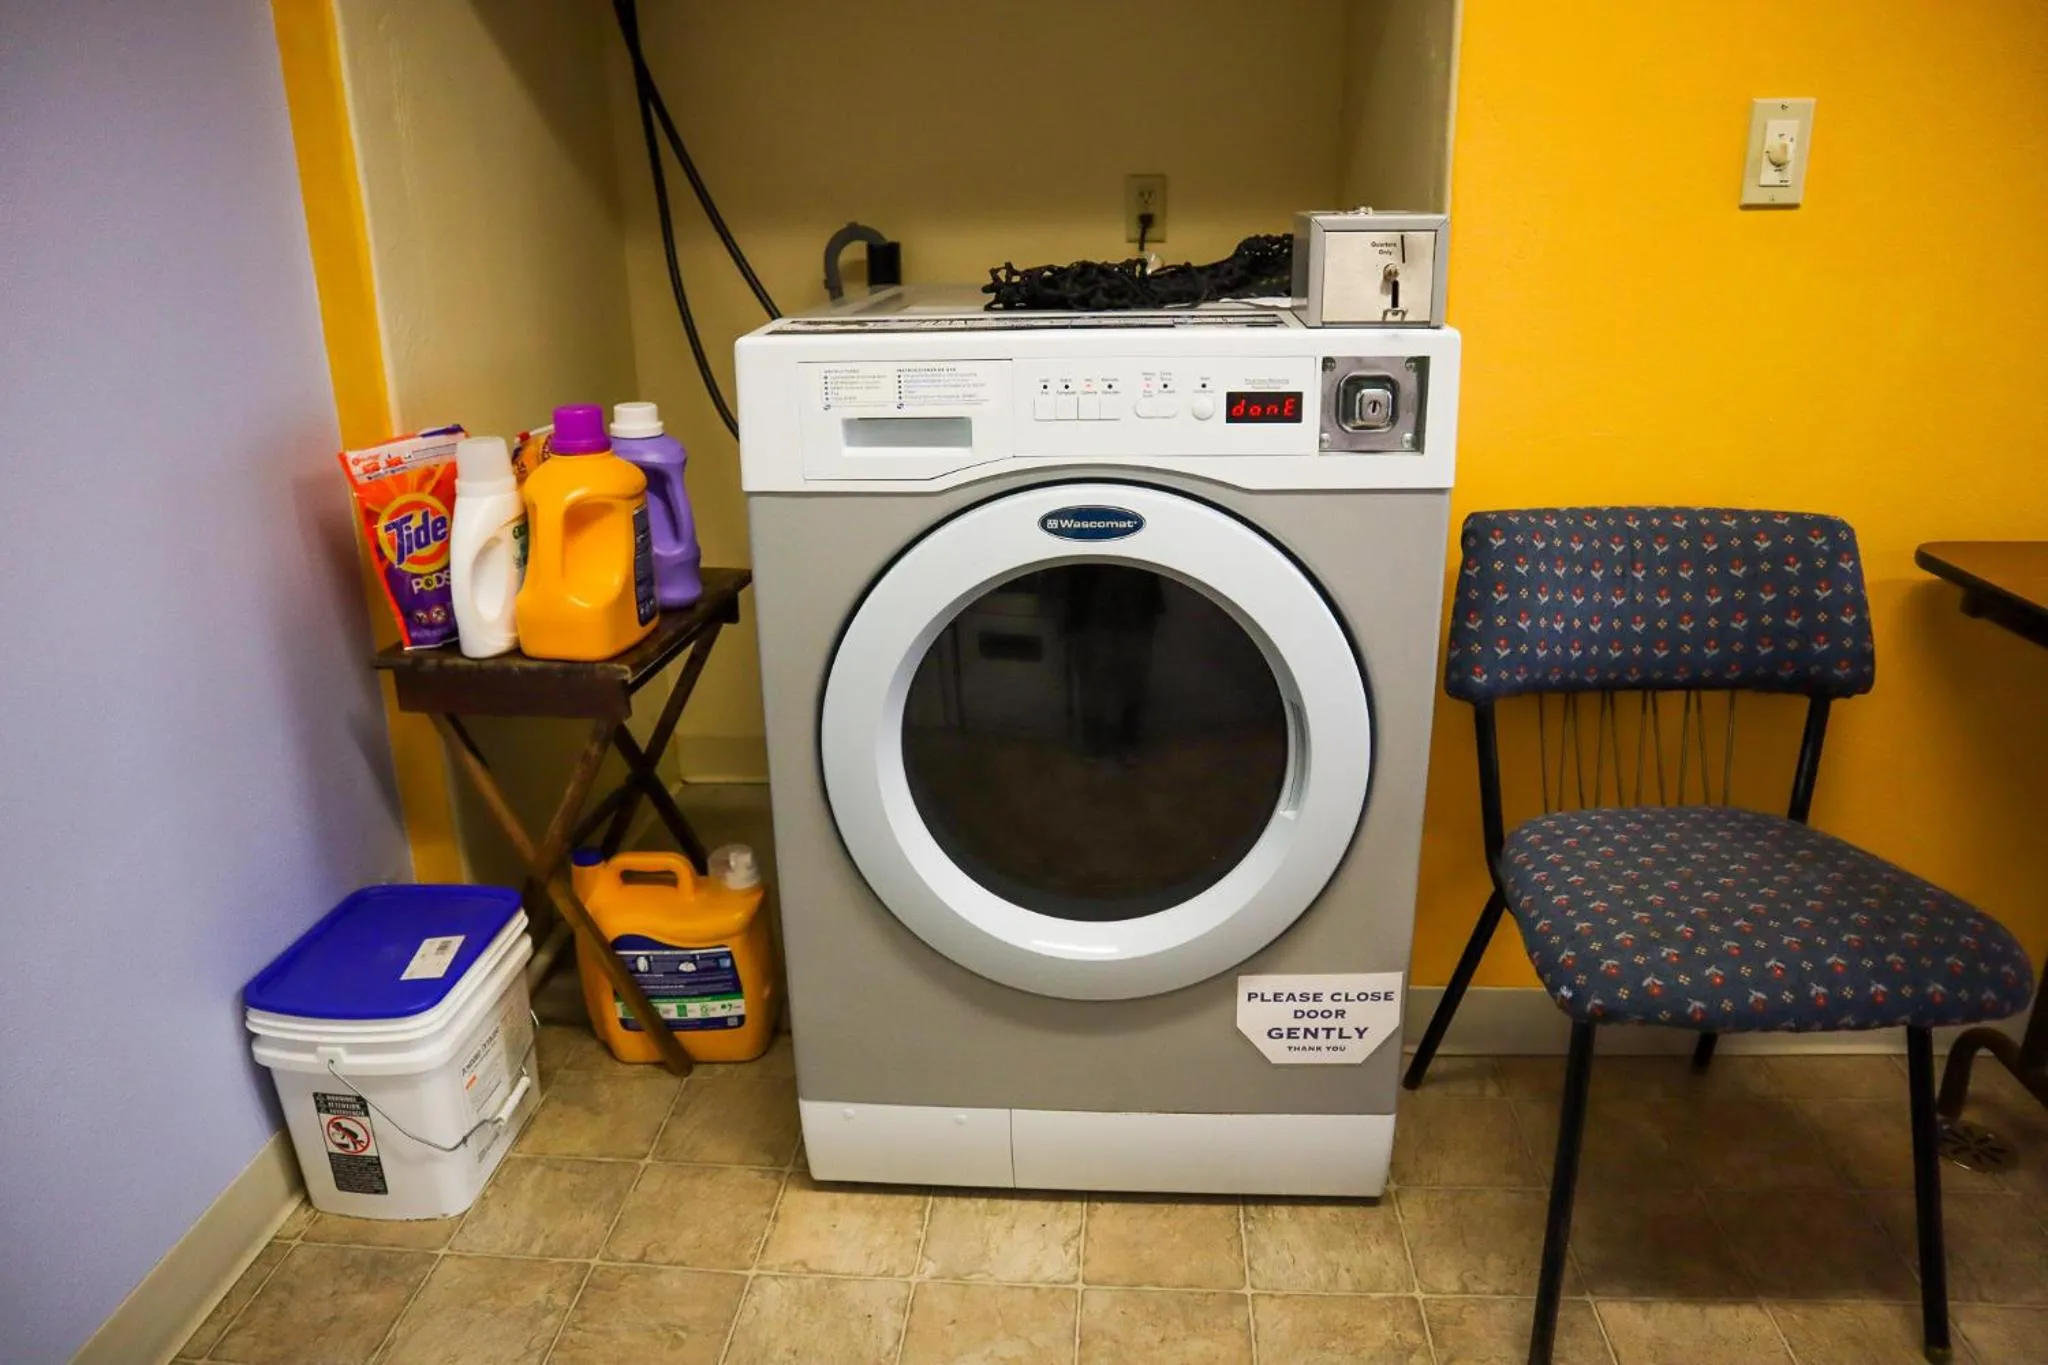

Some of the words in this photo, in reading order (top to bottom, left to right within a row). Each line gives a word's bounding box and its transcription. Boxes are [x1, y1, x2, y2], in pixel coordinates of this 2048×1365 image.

[1058, 518, 1134, 529] Wascomat
[383, 506, 449, 568] Tide
[1246, 991, 1324, 1003] PLEASE
[1330, 990, 1396, 1003] CLOSE
[1293, 1009, 1347, 1020] DOOR
[1266, 1026, 1370, 1040] GENTLY
[1286, 1045, 1323, 1053] THANK
[1325, 1045, 1347, 1053] YOU
